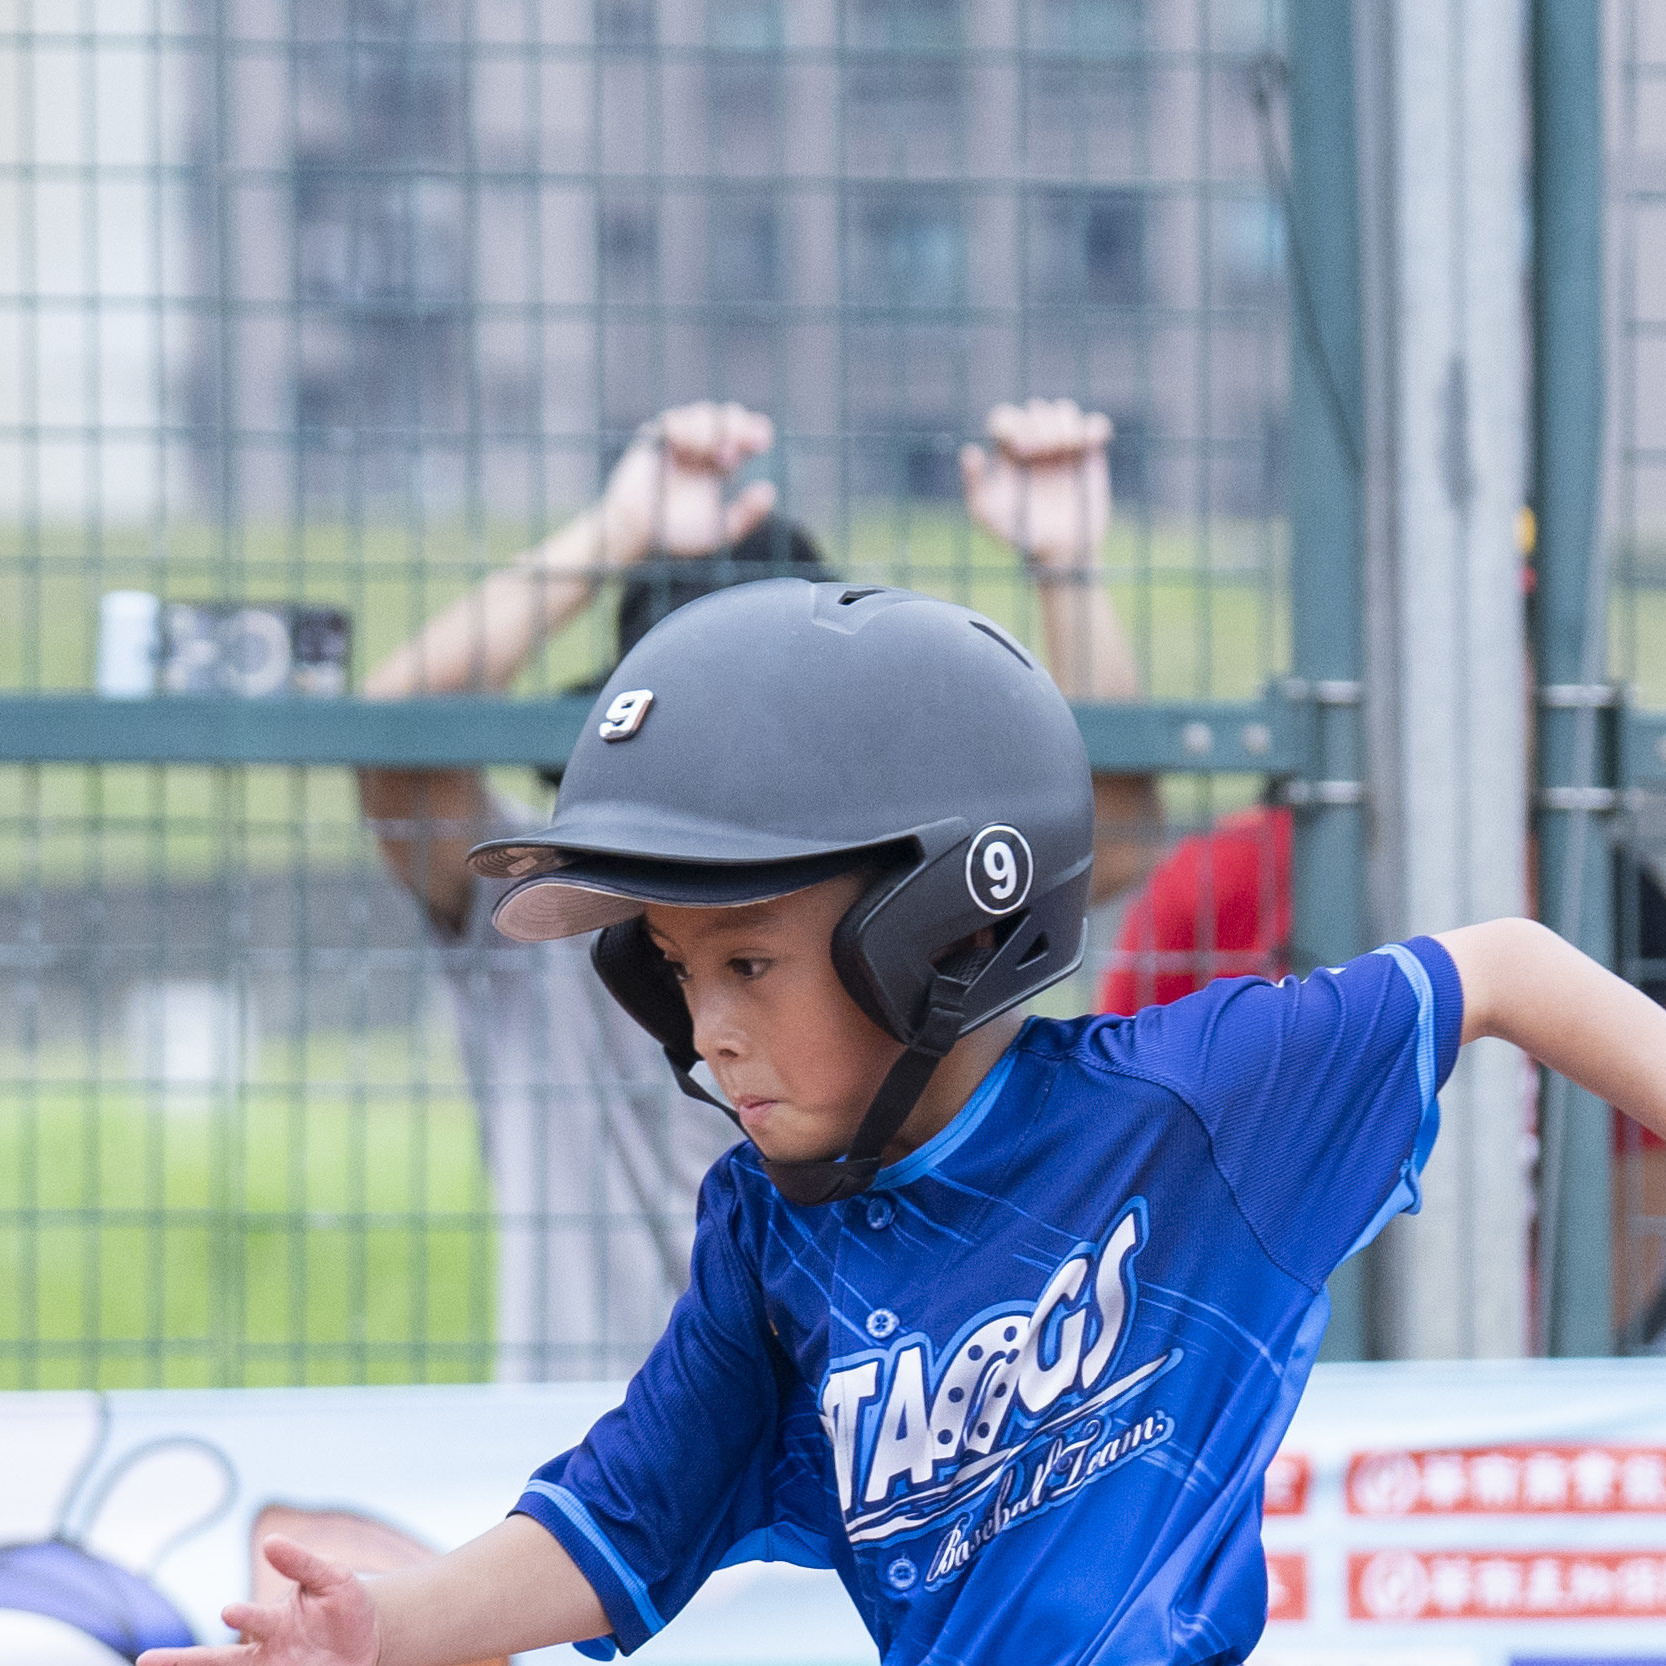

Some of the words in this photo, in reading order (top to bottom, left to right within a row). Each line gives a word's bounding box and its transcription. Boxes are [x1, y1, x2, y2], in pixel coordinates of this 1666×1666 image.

[599, 688, 654, 743] 9
[982, 840, 1018, 900] 9
[925, 1438, 1064, 1584] Baseball
[1051, 1417, 1164, 1498] Team
